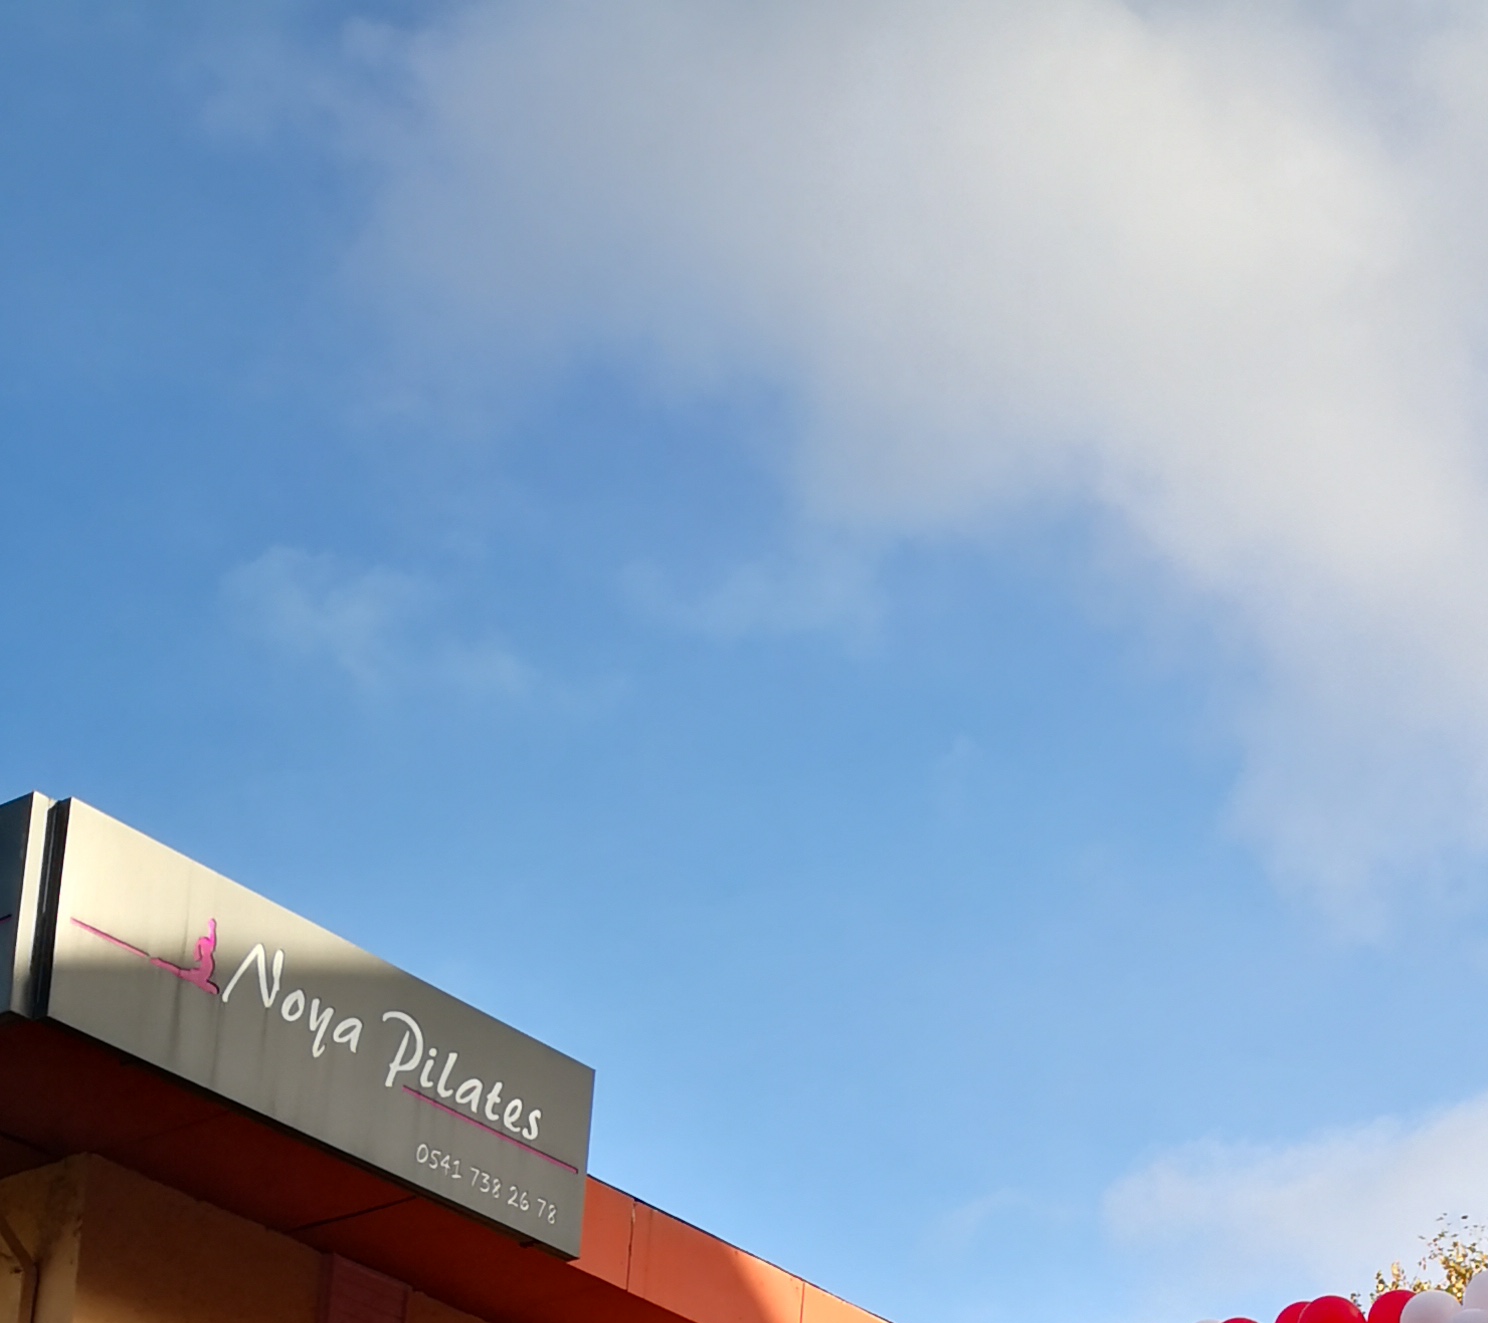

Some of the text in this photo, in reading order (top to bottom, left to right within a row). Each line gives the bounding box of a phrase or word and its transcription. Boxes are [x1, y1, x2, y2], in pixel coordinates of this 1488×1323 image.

[221, 943, 541, 1140] Noya Pilates
[416, 1143, 557, 1224] 0541 738 26 78
